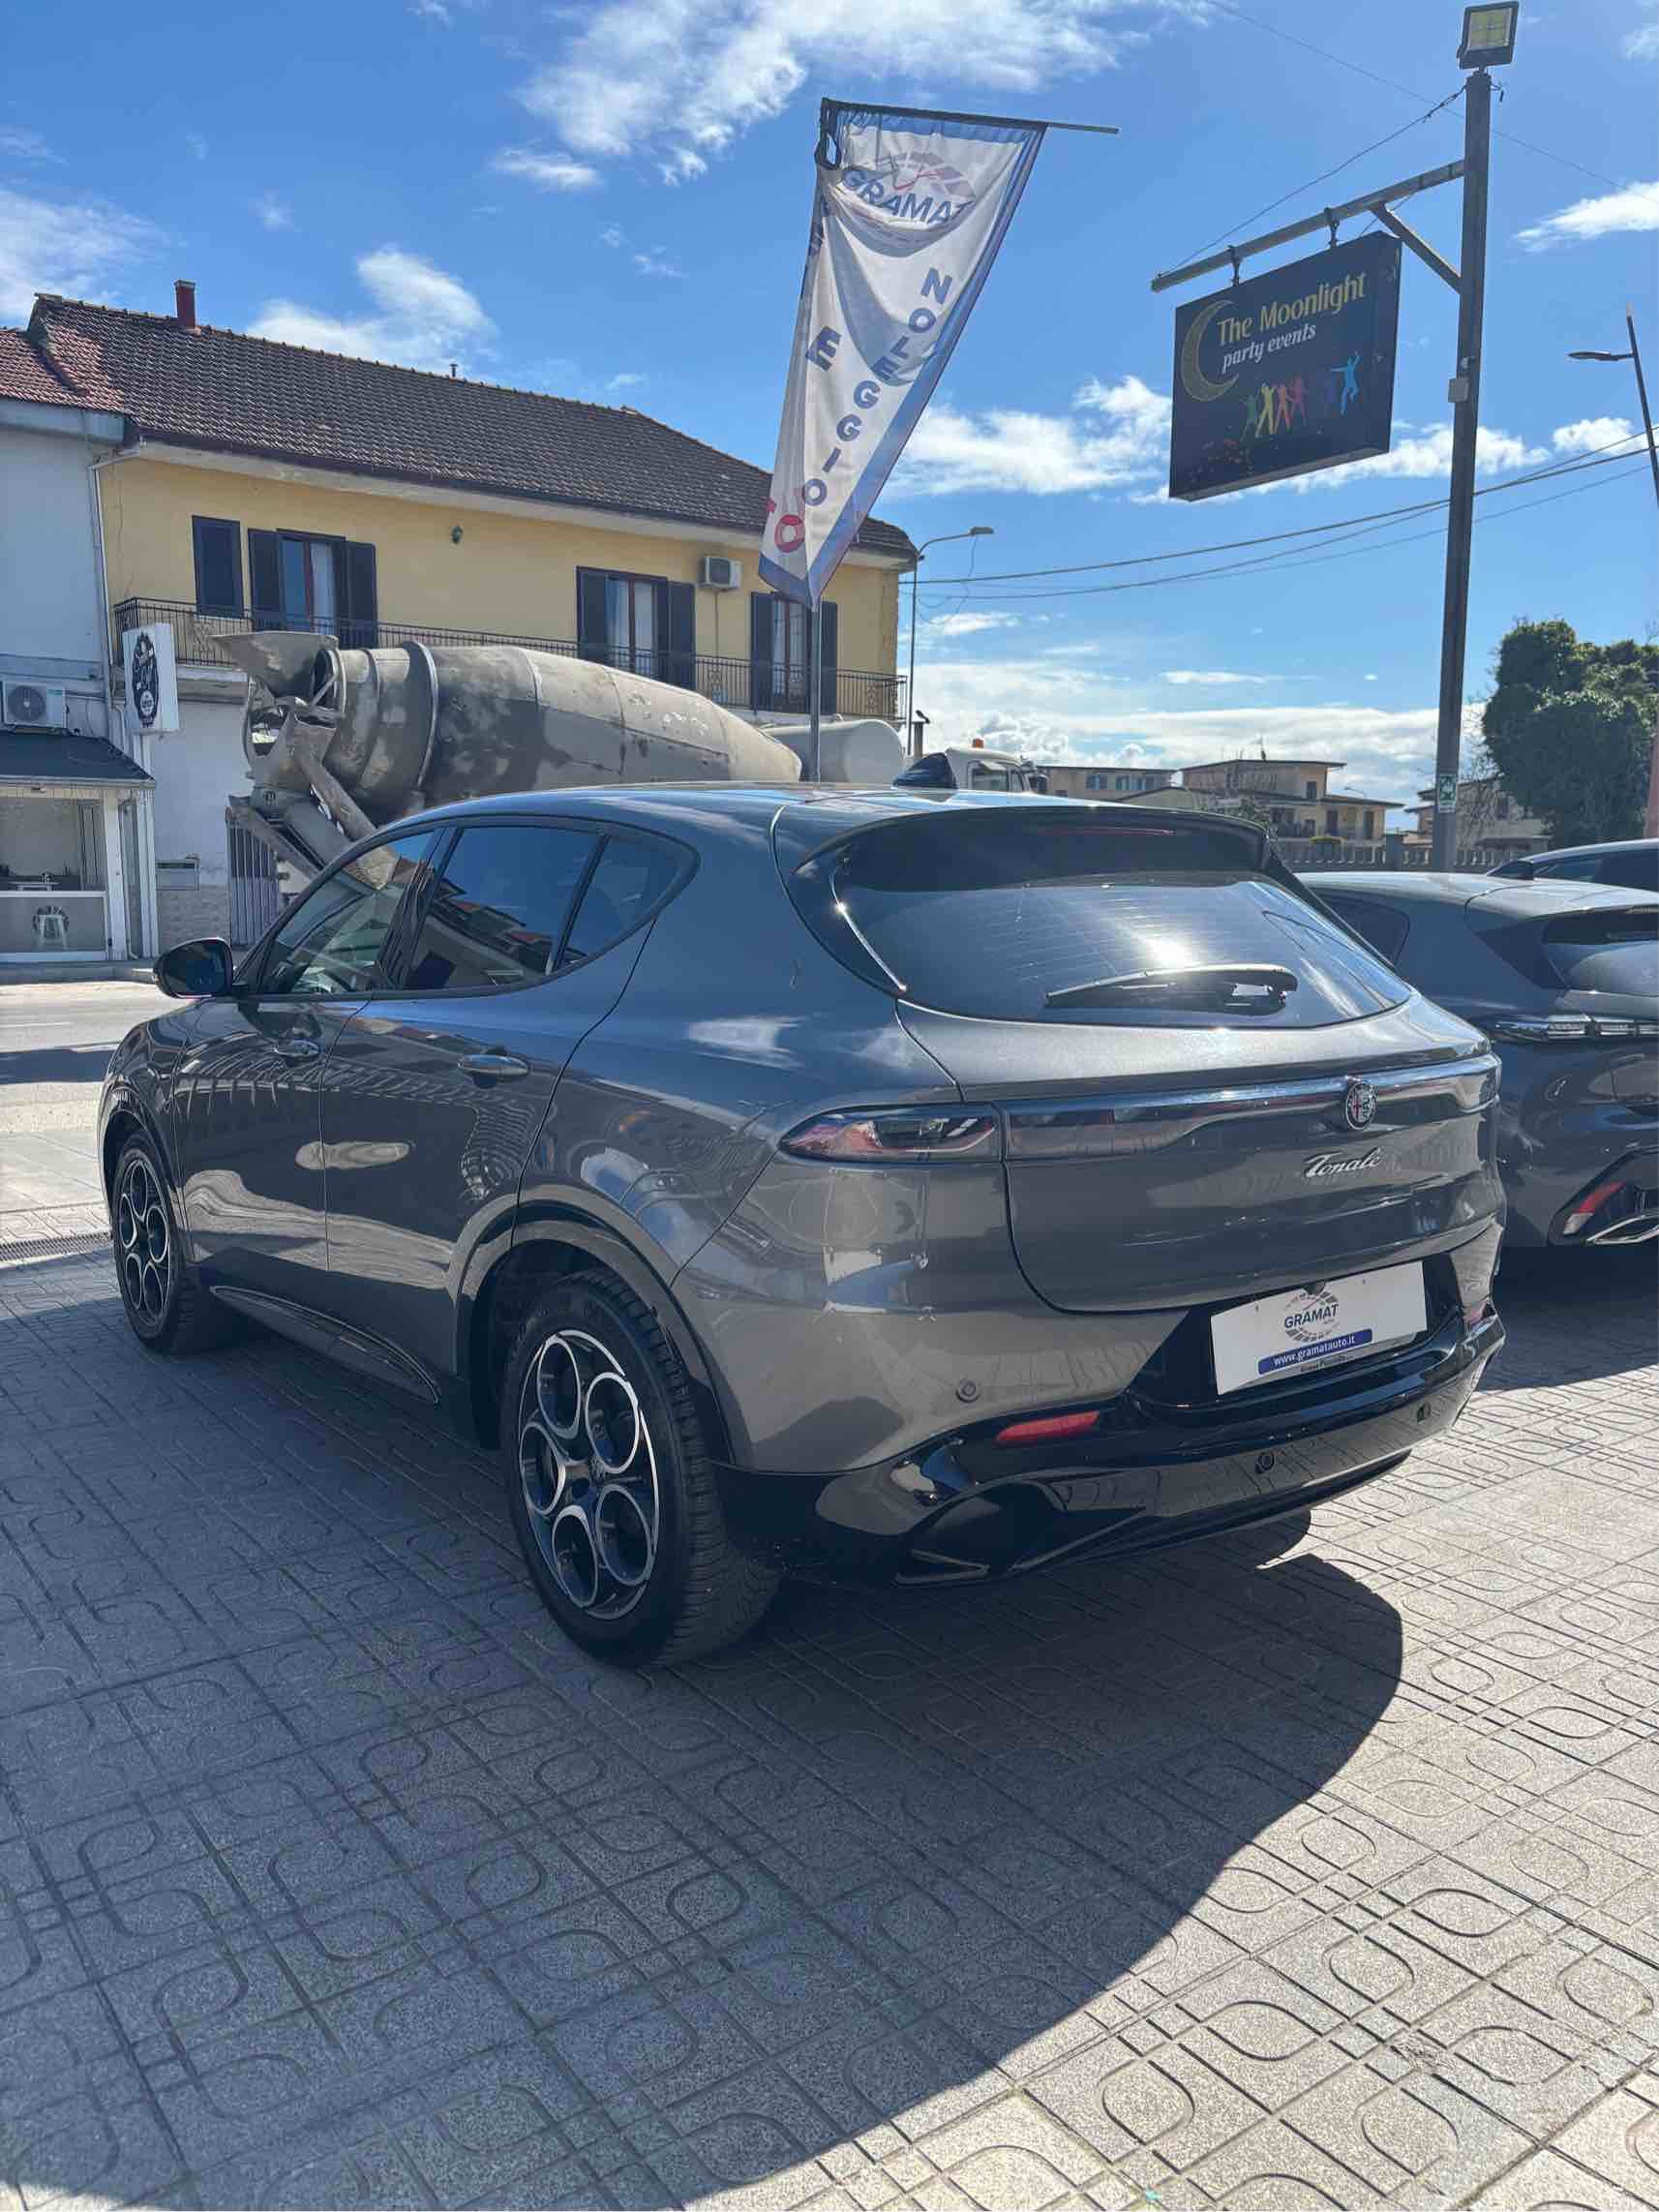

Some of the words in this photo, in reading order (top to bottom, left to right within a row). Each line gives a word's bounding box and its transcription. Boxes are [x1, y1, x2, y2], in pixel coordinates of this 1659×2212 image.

[1217, 316, 1254, 346] The
[1259, 271, 1367, 332] Moonlight
[1222, 343, 1264, 375] party
[1267, 322, 1316, 352] events
[802, 267, 953, 507] NOLEGGIO
[1304, 1146, 1381, 1178] Tonale
[1284, 1303, 1340, 1329] GRAMAT
[1273, 1335, 1355, 1367] www.gramatauto.it
